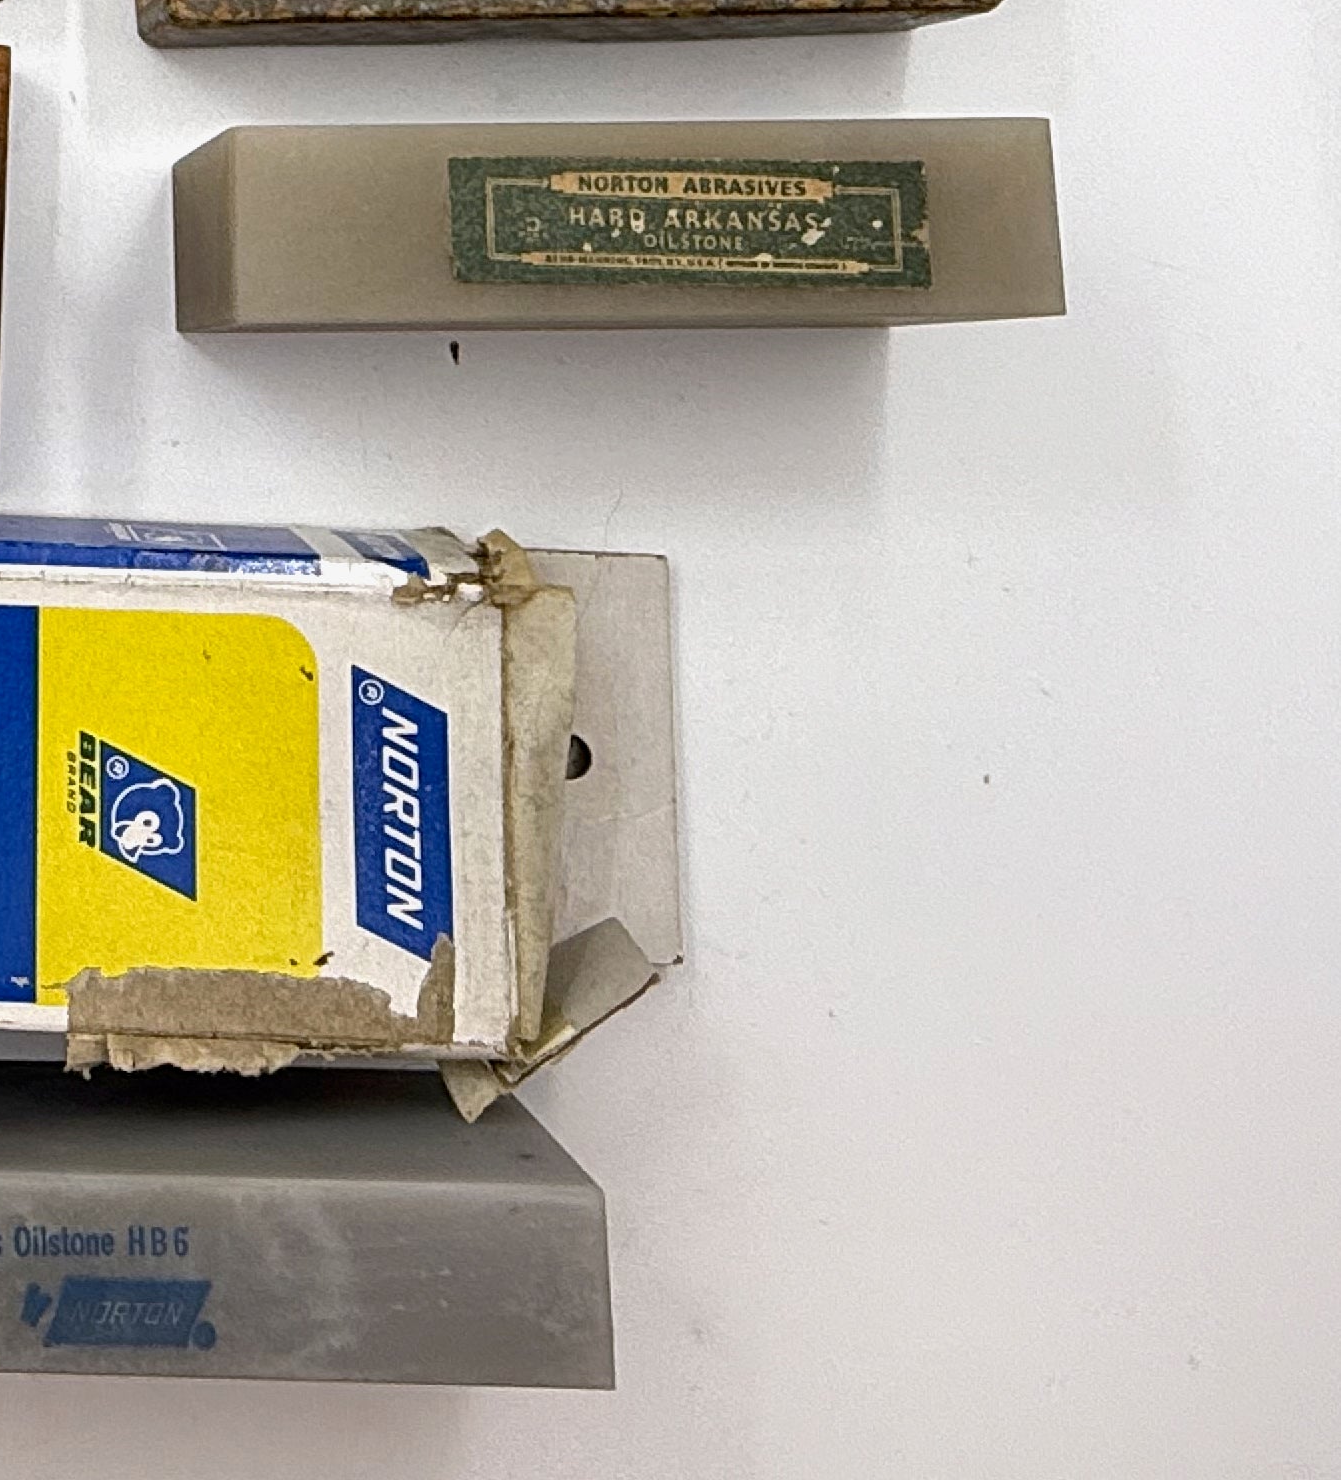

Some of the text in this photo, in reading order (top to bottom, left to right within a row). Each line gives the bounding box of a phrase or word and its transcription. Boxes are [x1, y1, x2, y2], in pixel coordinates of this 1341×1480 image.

[578, 174, 807, 197] NORTON ABRASIVES
[568, 206, 819, 232] HARD ARKANSAS
[643, 233, 744, 251] OILSTONE
[65, 749, 78, 814] BRAND
[78, 730, 97, 848] BEAR
[381, 707, 424, 931] NORTON
[13, 1226, 116, 1258] Oilstone
